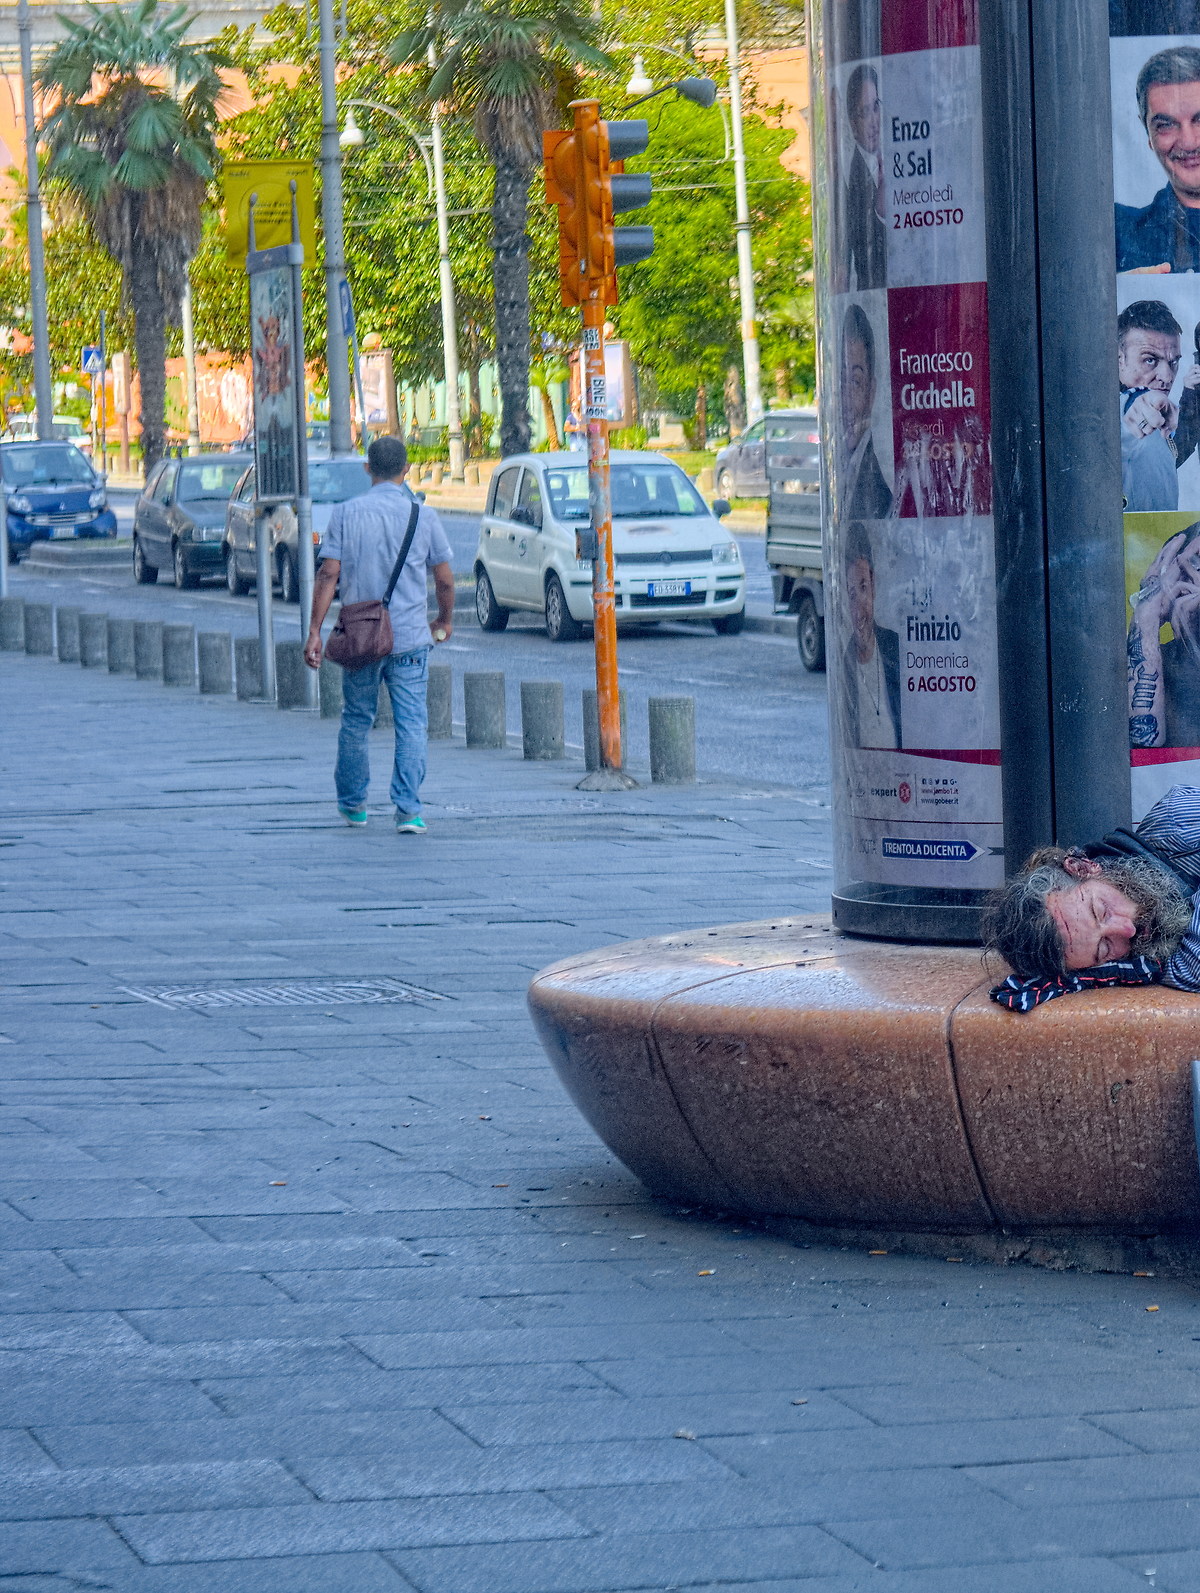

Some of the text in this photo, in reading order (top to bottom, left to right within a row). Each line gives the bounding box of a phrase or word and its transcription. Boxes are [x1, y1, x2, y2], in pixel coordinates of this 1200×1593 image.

[891, 116, 931, 142] Enzo
[892, 148, 933, 178] & Sal
[892, 183, 954, 206] Mercoledì
[893, 207, 964, 229] 2 AGOSTO
[900, 348, 973, 375] Francesco
[901, 380, 976, 411] Cicchella
[906, 614, 961, 641] Finizio
[906, 652, 969, 669] Domenica
[907, 675, 976, 692] 6 AGOSTO
[884, 841, 923, 856] TRENTOLA
[923, 844, 967, 857] DUCENTA
